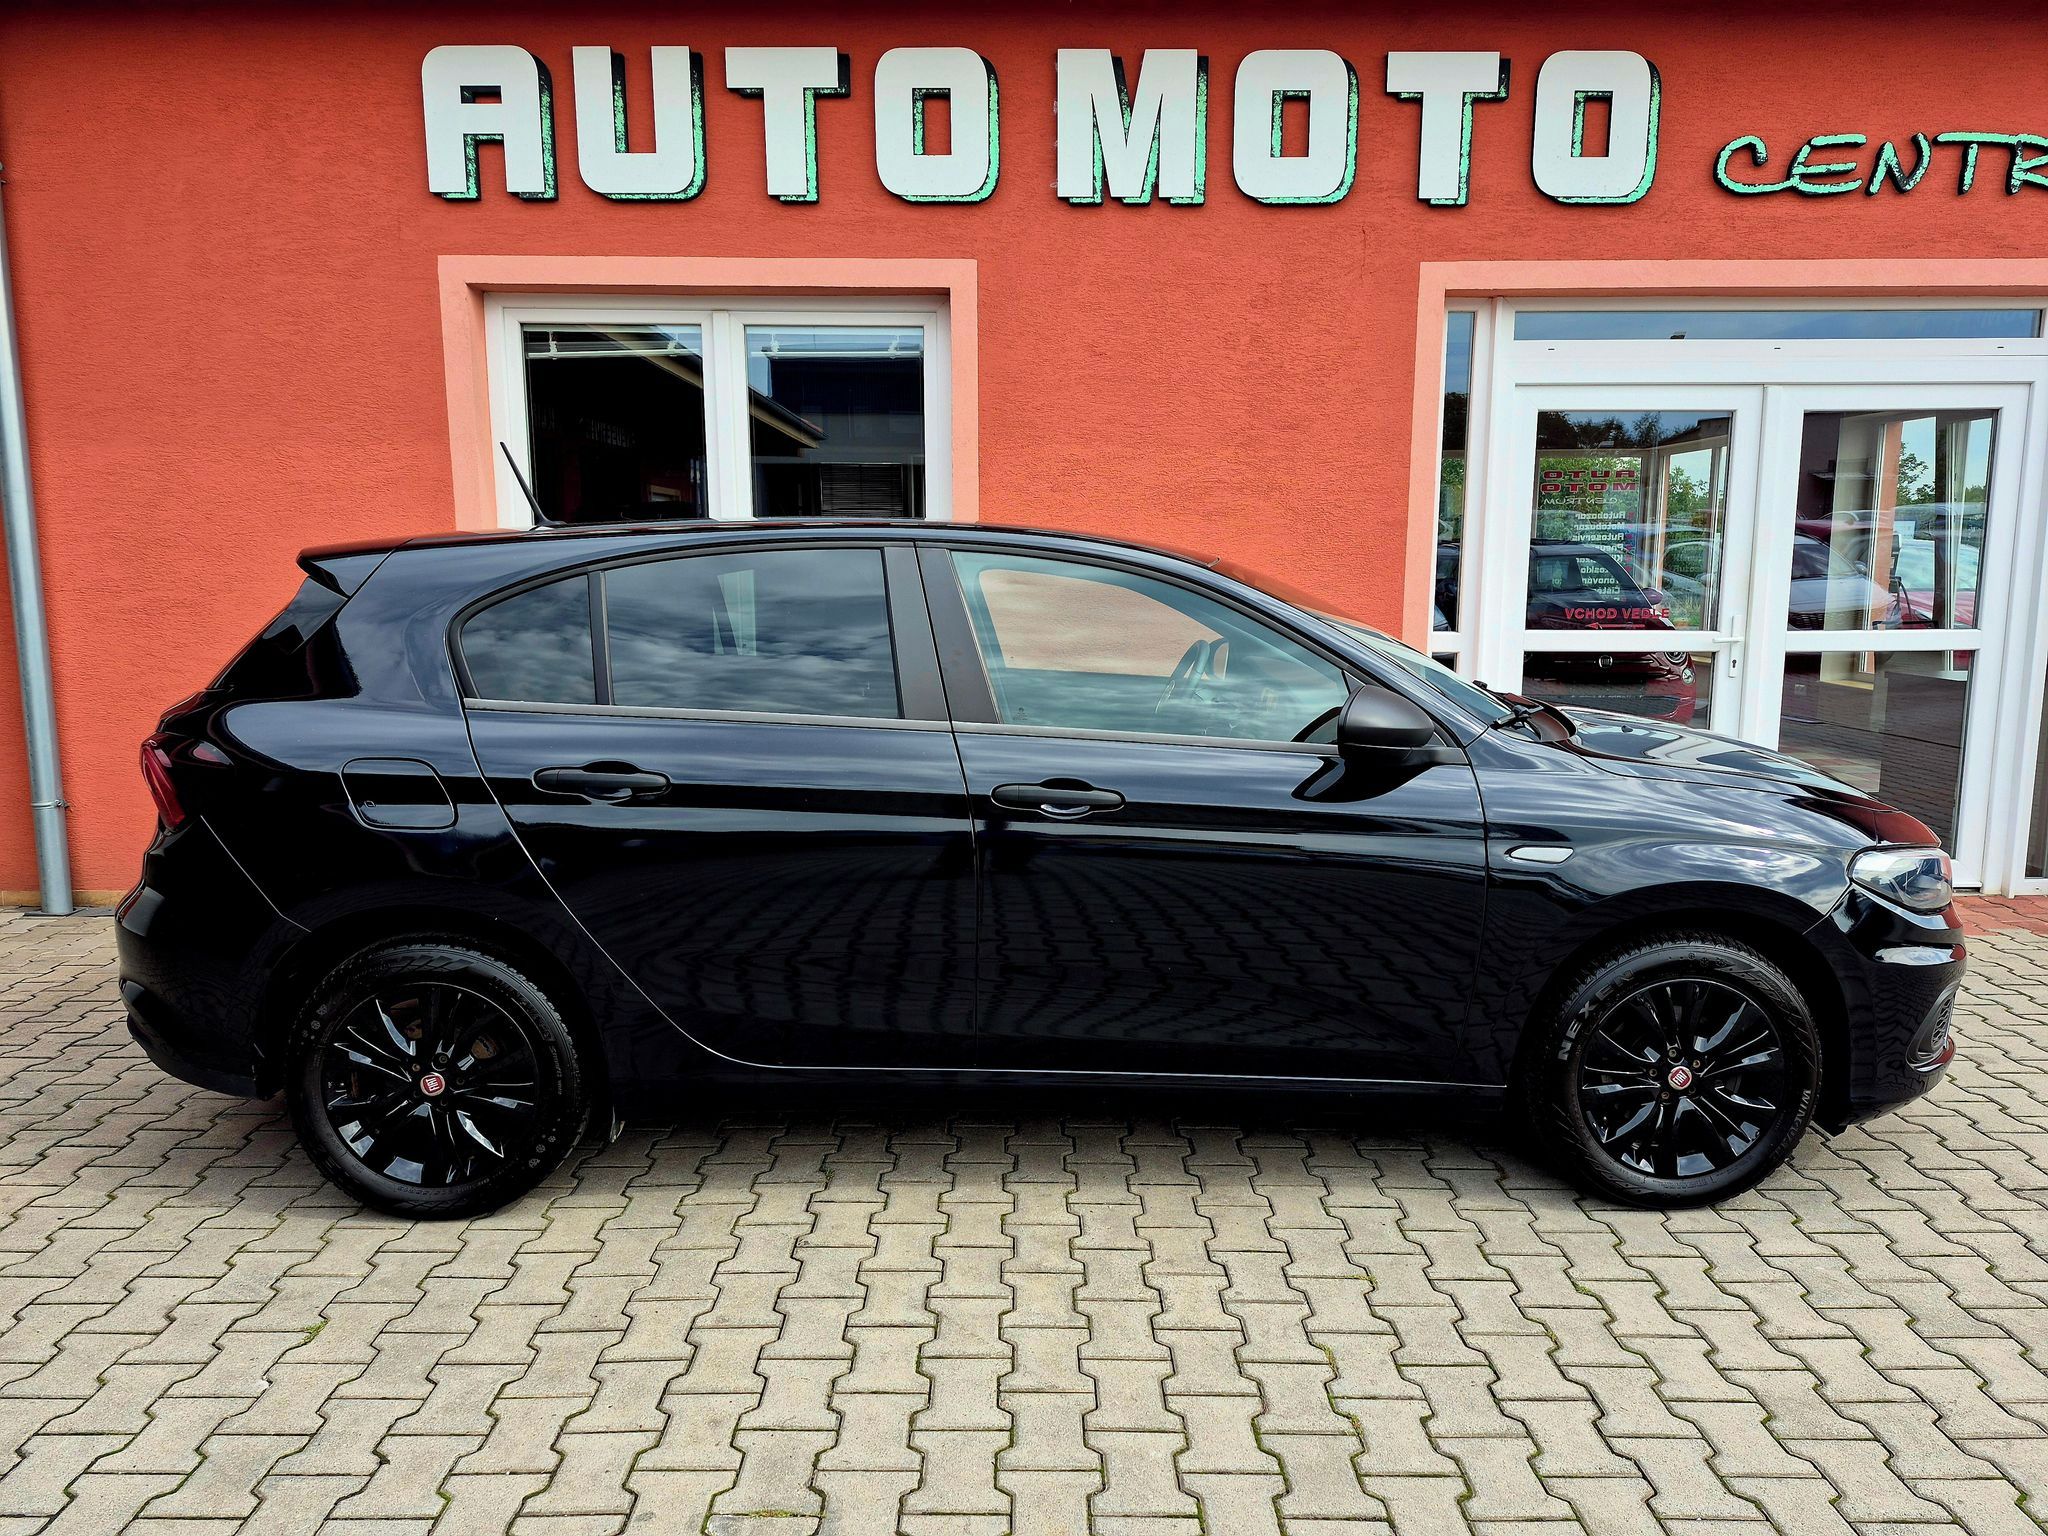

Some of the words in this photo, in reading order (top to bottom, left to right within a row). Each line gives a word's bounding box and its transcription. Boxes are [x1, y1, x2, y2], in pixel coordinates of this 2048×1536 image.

[421, 45, 1000, 203] AUTO
[1056, 48, 1661, 205] MOTO
[1713, 132, 2048, 196] CENTR
[1564, 608, 1617, 619] VCHOD
[1622, 607, 1670, 619] VEDLE
[1557, 969, 1634, 1061] NEXEN
